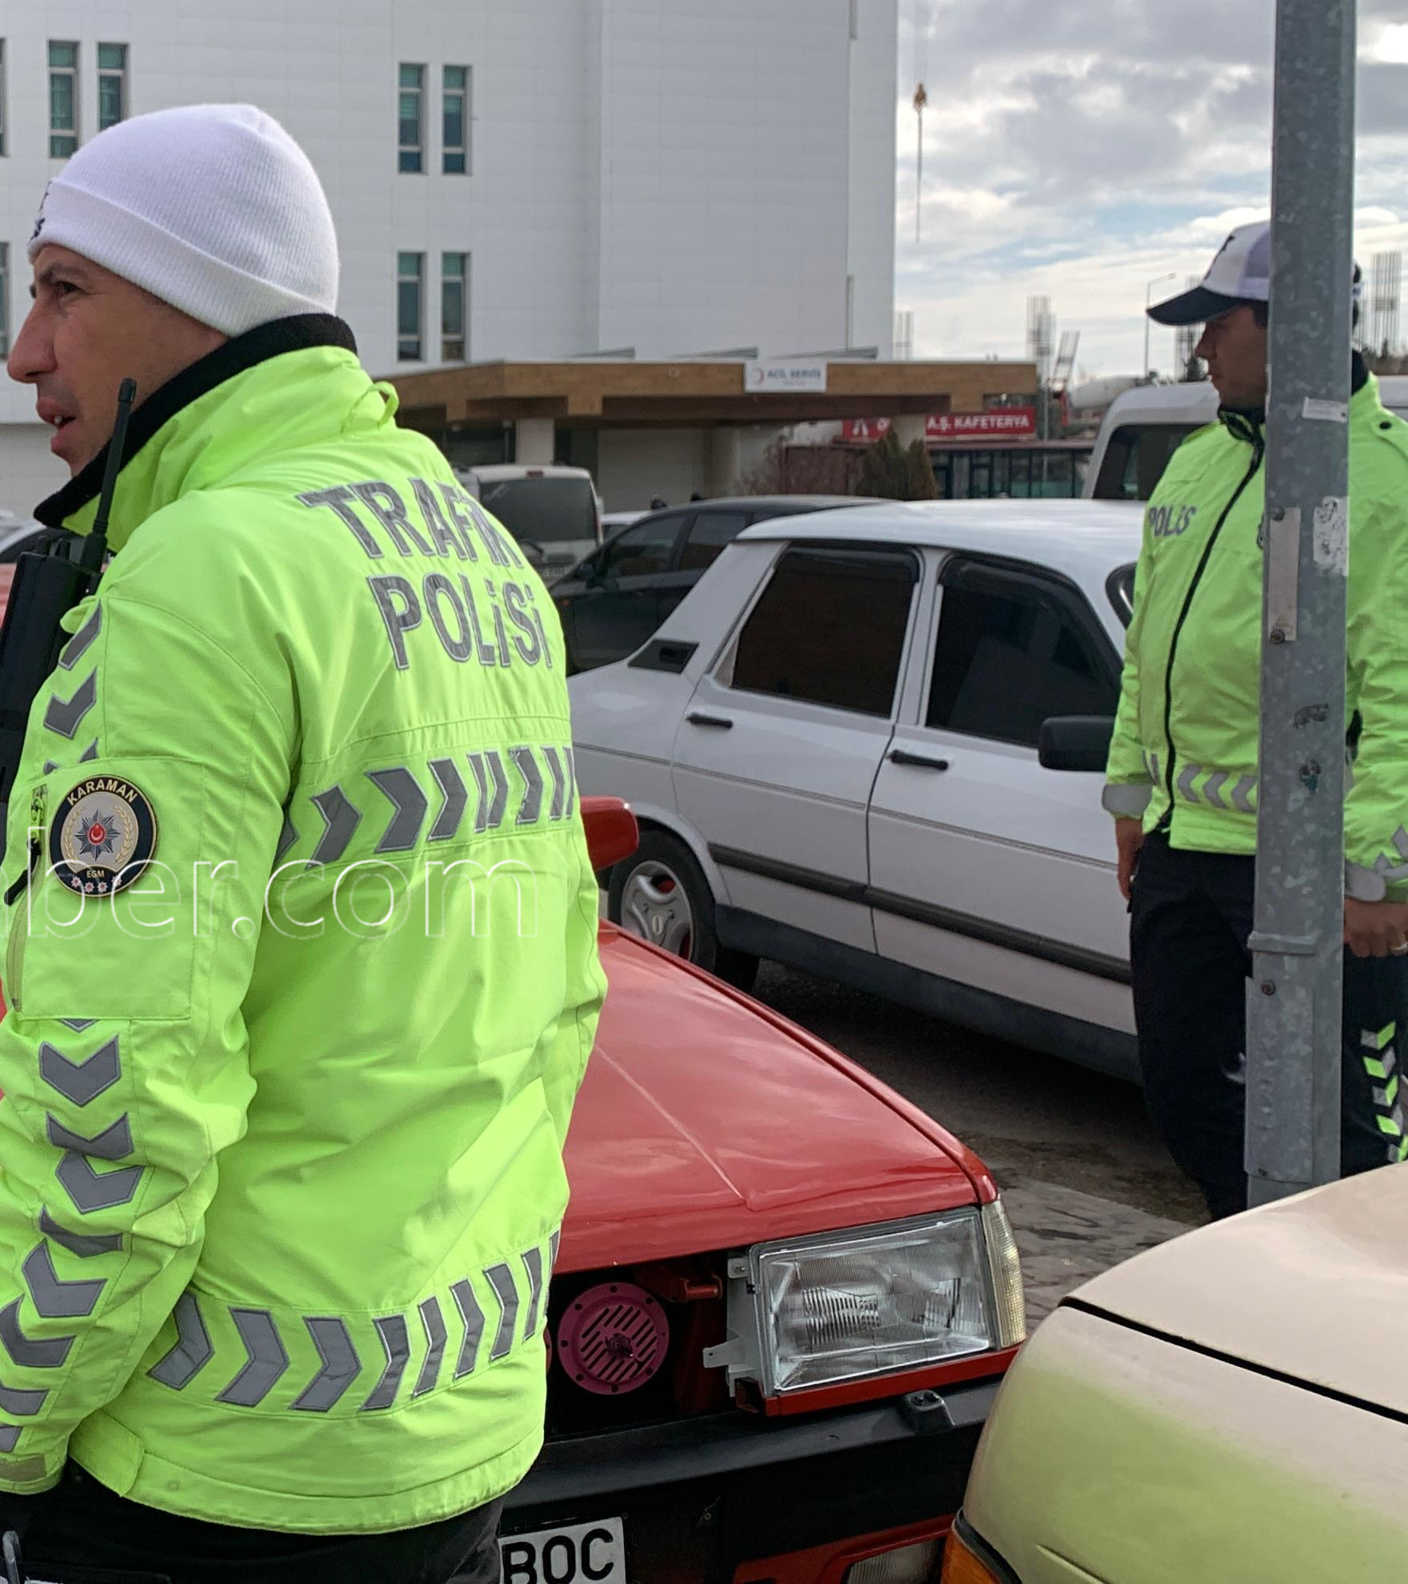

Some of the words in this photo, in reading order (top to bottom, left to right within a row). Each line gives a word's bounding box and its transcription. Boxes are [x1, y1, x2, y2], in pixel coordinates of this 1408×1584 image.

[954, 413, 1030, 430] KAFETERYA
[67, 779, 138, 806] KARAMAN
[86, 869, 105, 879] EGM
[501, 1528, 615, 1584] BOC
